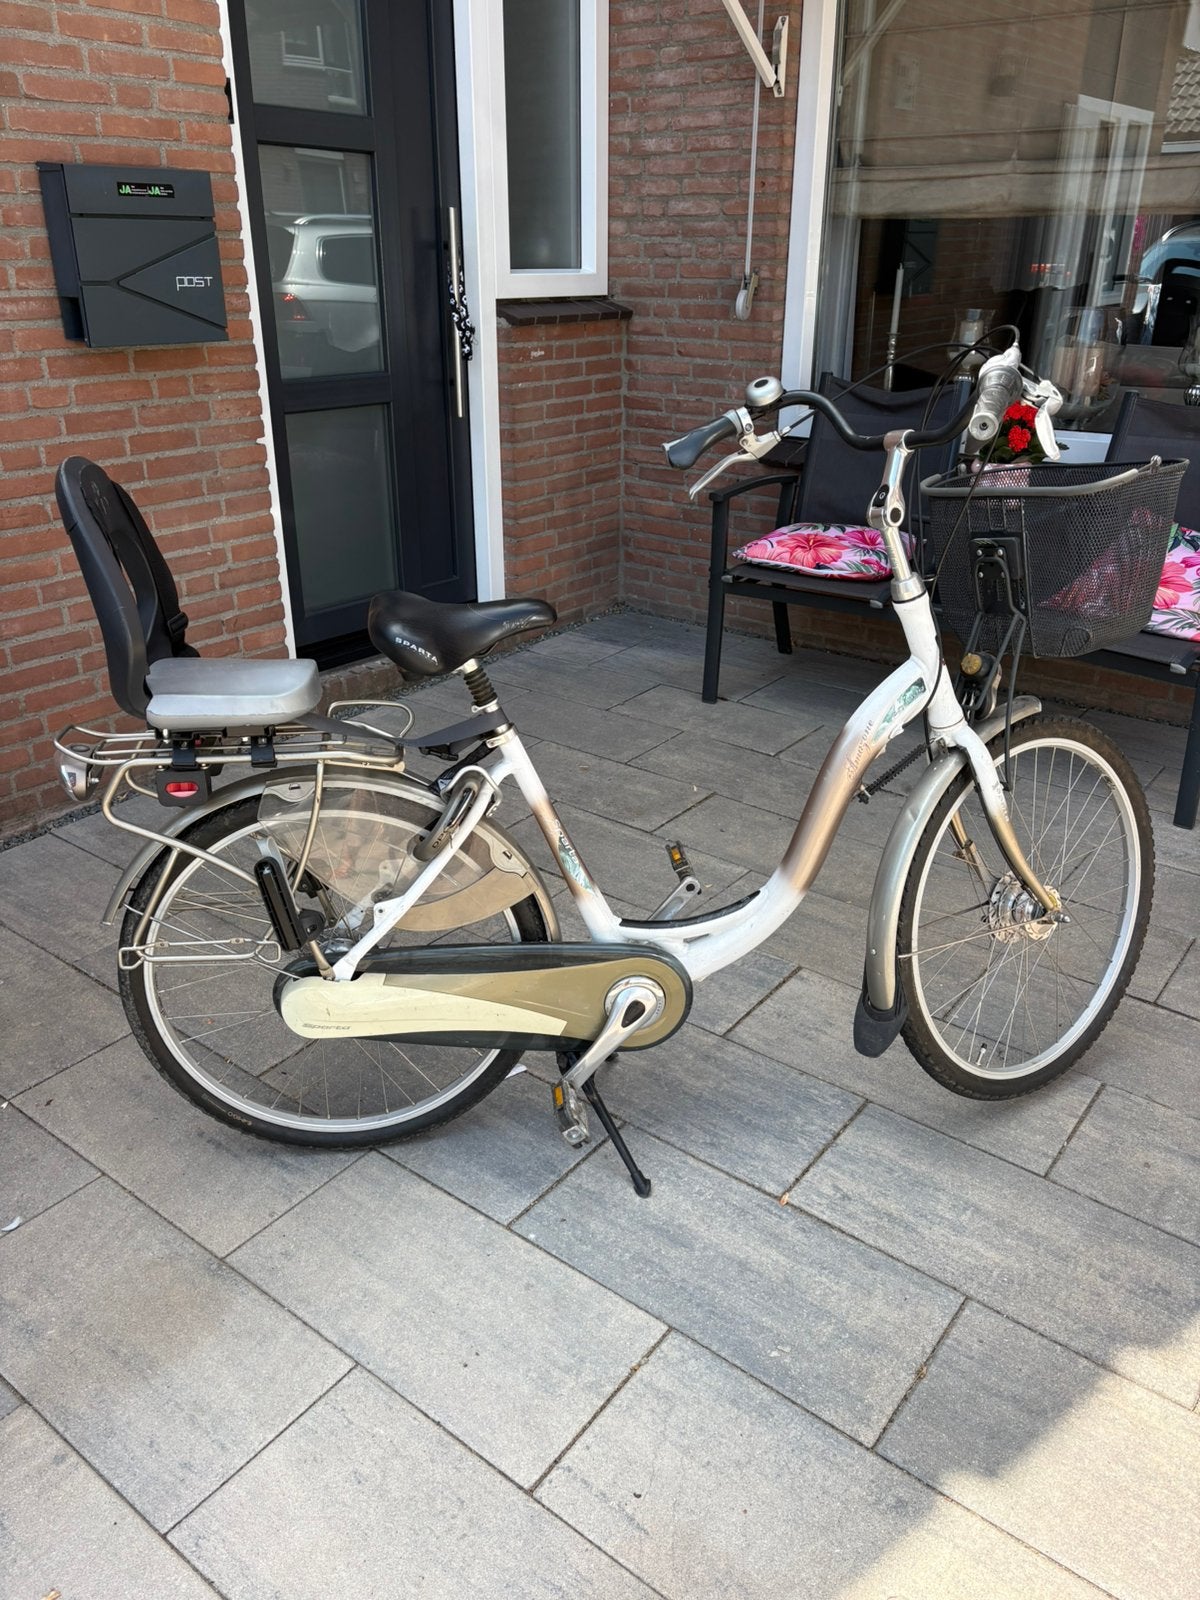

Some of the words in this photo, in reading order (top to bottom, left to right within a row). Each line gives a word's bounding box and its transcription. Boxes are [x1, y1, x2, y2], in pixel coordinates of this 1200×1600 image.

[119, 184, 131, 194] JA
[148, 186, 160, 195] JA
[395, 636, 438, 665] SPARTA
[554, 818, 579, 864] Sparta
